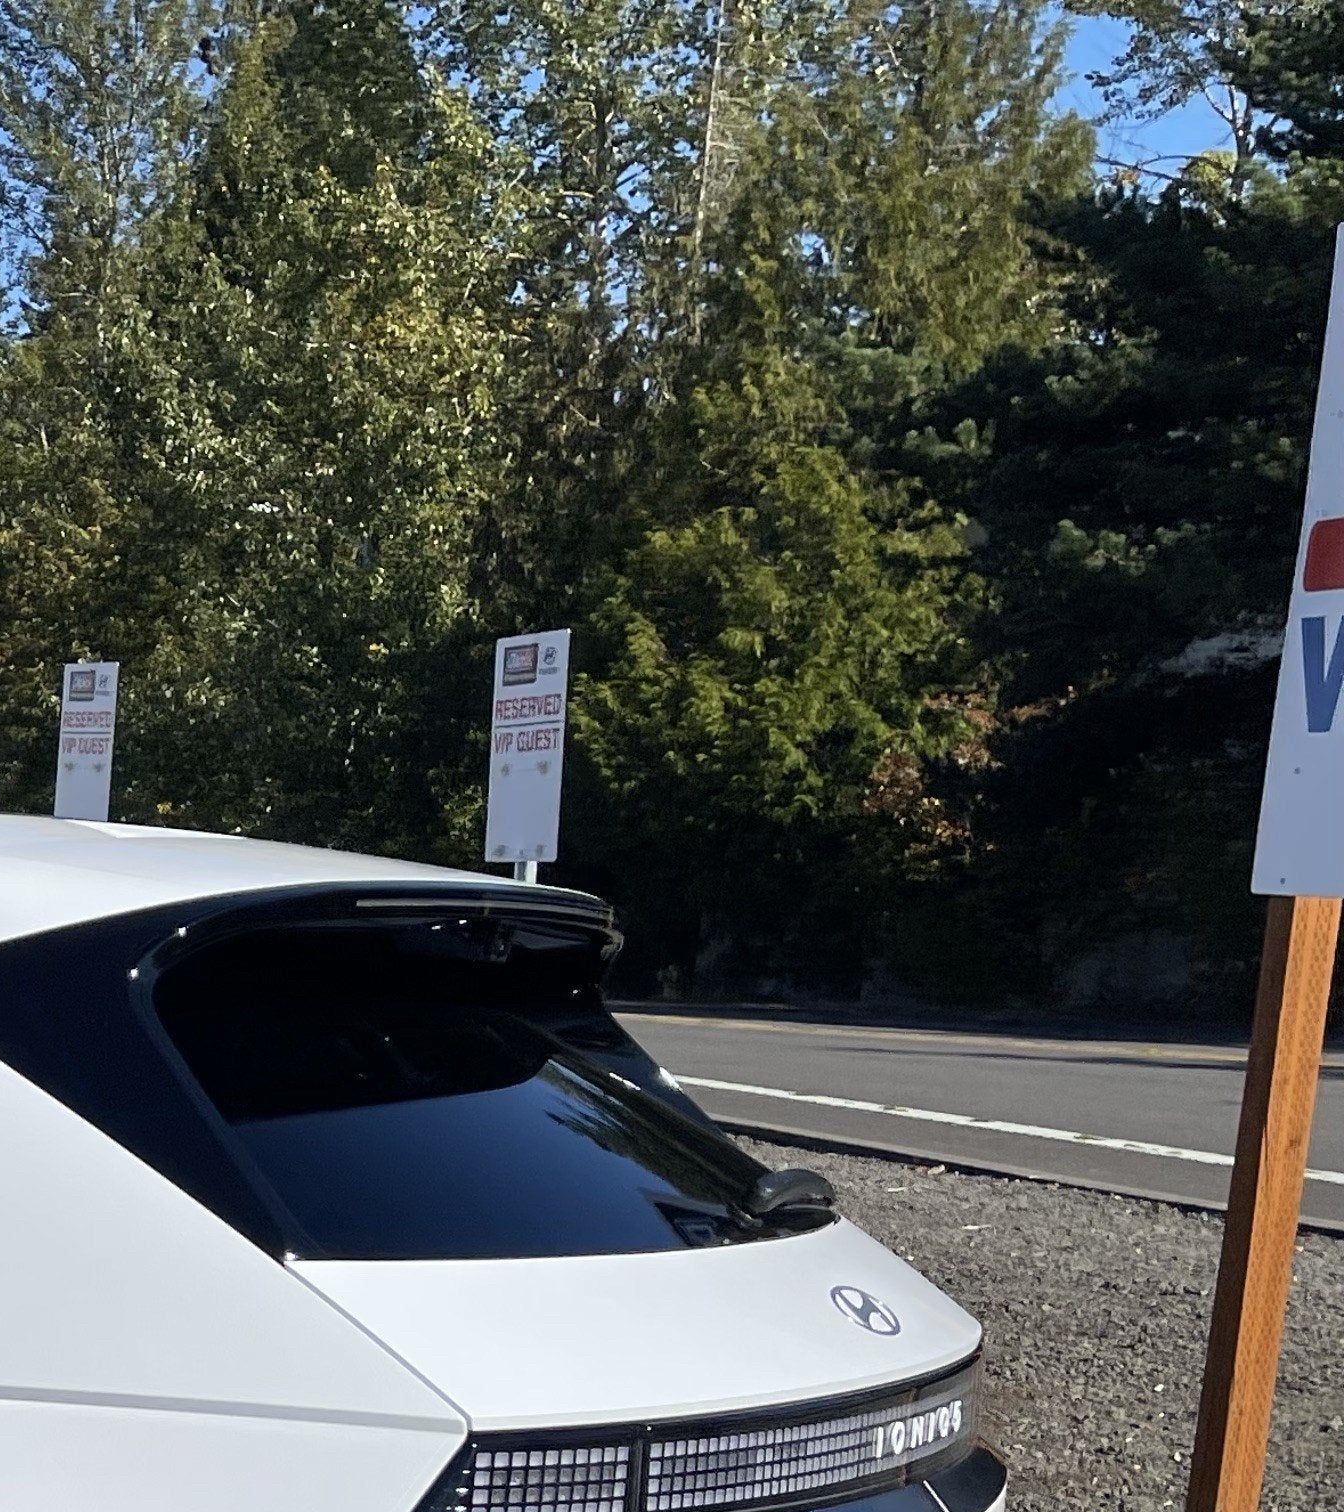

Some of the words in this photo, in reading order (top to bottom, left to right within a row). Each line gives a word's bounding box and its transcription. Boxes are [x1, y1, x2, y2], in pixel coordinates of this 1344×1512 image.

[495, 693, 562, 720] RESERVED
[494, 732, 513, 754] VIP
[517, 728, 560, 752] GUEST
